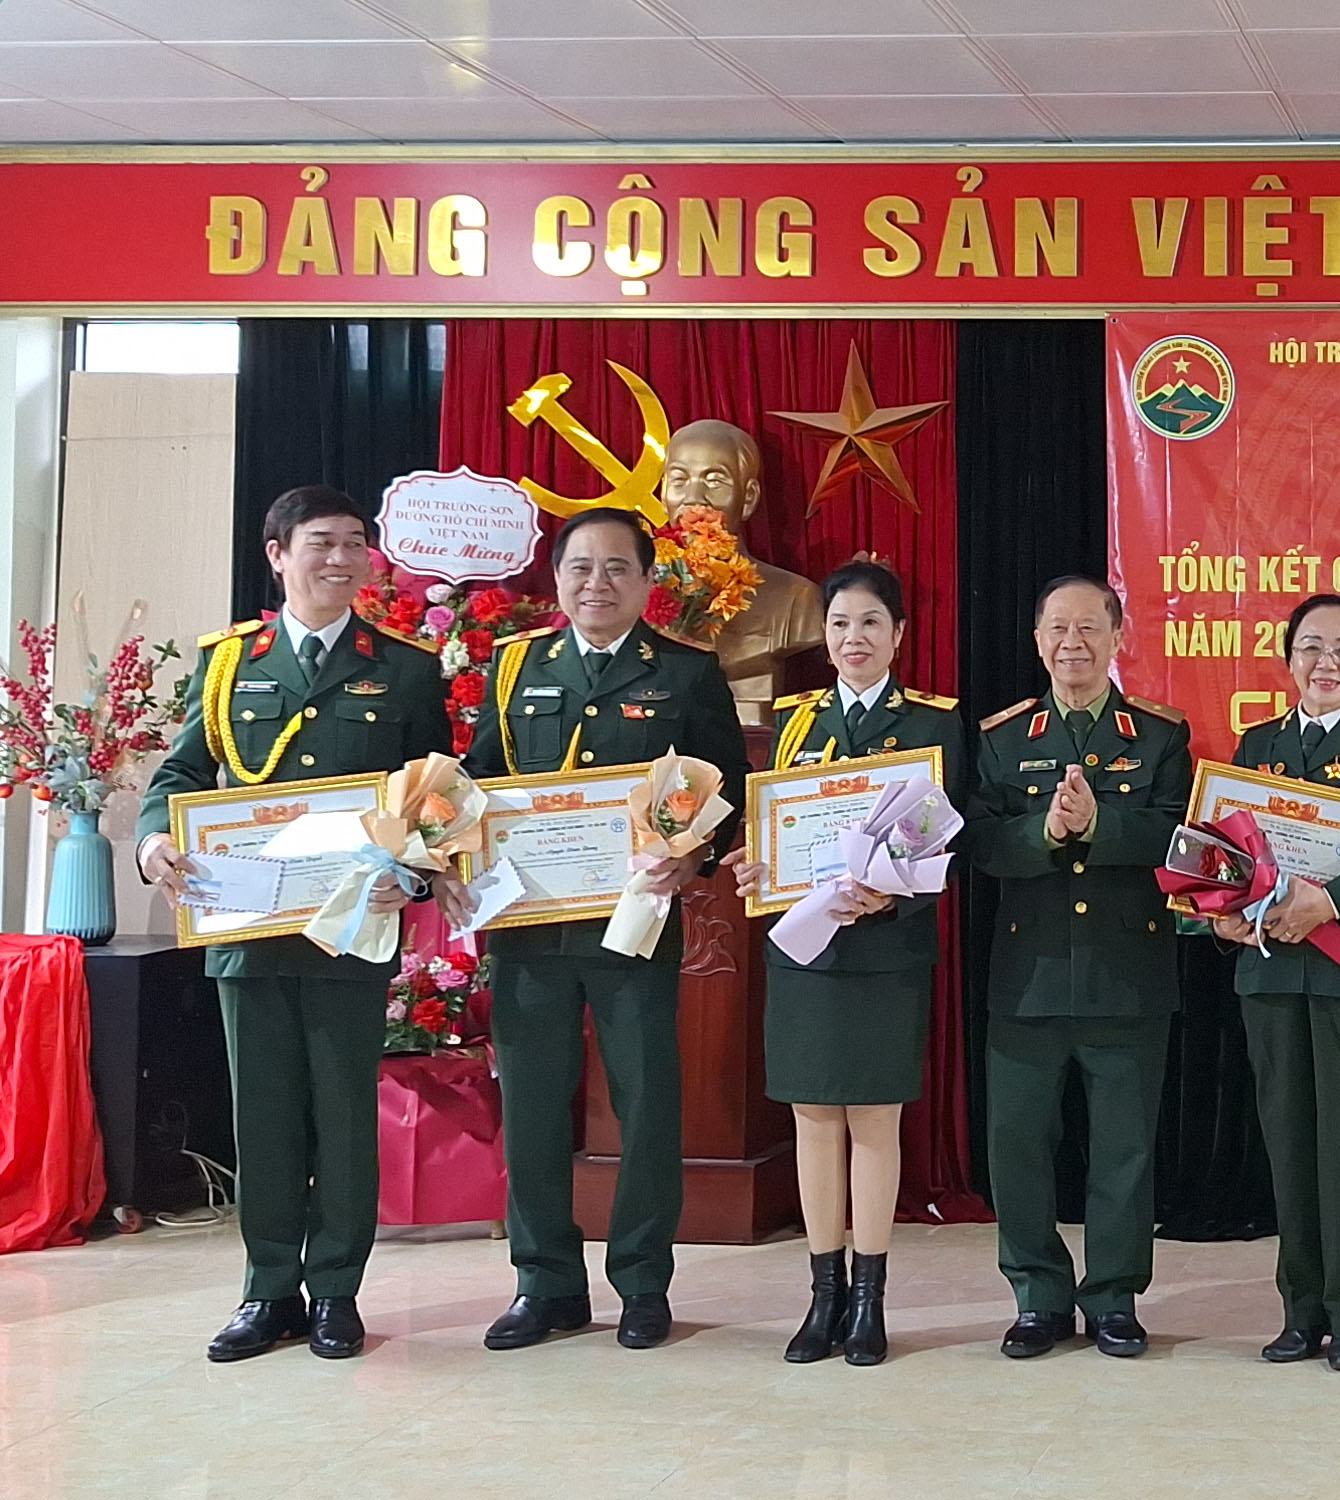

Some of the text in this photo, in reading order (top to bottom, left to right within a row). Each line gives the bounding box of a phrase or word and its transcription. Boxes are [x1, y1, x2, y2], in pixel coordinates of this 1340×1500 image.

[205, 166, 488, 277] ĐẢNG
[532, 173, 813, 296] CỘNG
[863, 166, 1078, 278] SẢN
[1269, 338, 1307, 368] HỘI
[408, 498, 514, 516] HỘI TRƯỜNG SƠN
[428, 526, 489, 541] VIỆT NAM
[466, 514, 488, 527] CHÍ
[491, 519, 524, 531] MINH
[398, 537, 448, 557] Chúc
[1159, 541, 1246, 593] TỔNG
[1259, 544, 1322, 592] KẾT
[1164, 612, 1241, 657] NĂM
